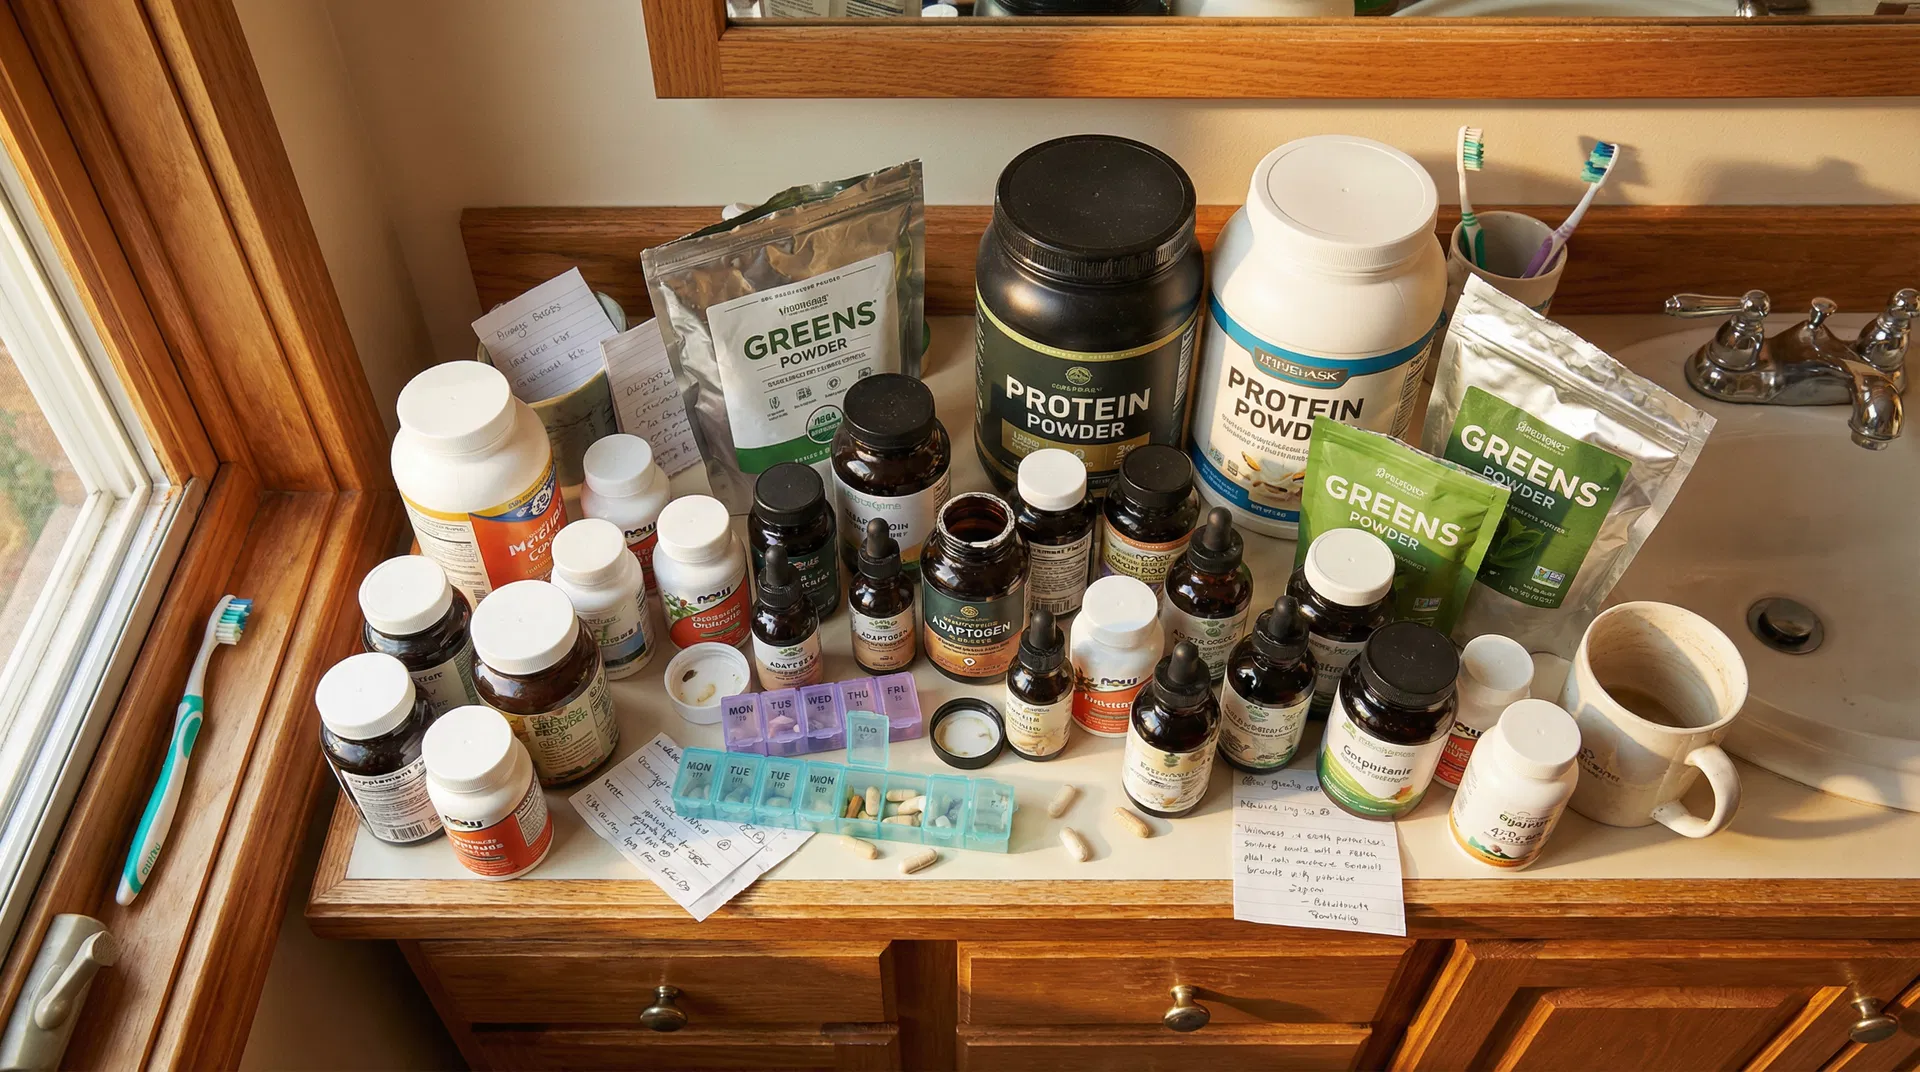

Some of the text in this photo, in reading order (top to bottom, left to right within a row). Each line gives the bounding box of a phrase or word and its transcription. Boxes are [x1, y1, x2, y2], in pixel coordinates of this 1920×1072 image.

[744, 300, 878, 361] GREENS
[780, 338, 848, 369] POWDER
[1006, 374, 1152, 421] PROTEIN
[1228, 365, 1365, 422] PROTEIN
[1027, 412, 1126, 440] POWDER
[1234, 398, 1313, 442] POWD
[1460, 424, 1602, 507] GREENS
[1483, 465, 1557, 510] POWDER
[1325, 475, 1463, 547] GREENS
[1349, 511, 1420, 551] POWDER
[932, 615, 1011, 638] ADAPTOGEN
[729, 704, 755, 716] MON
[771, 700, 792, 710] TUS
[807, 694, 832, 705] WED
[847, 690, 870, 700] THU
[687, 761, 712, 772] MON
[730, 765, 751, 777] TUE
[770, 770, 791, 781] TUE
